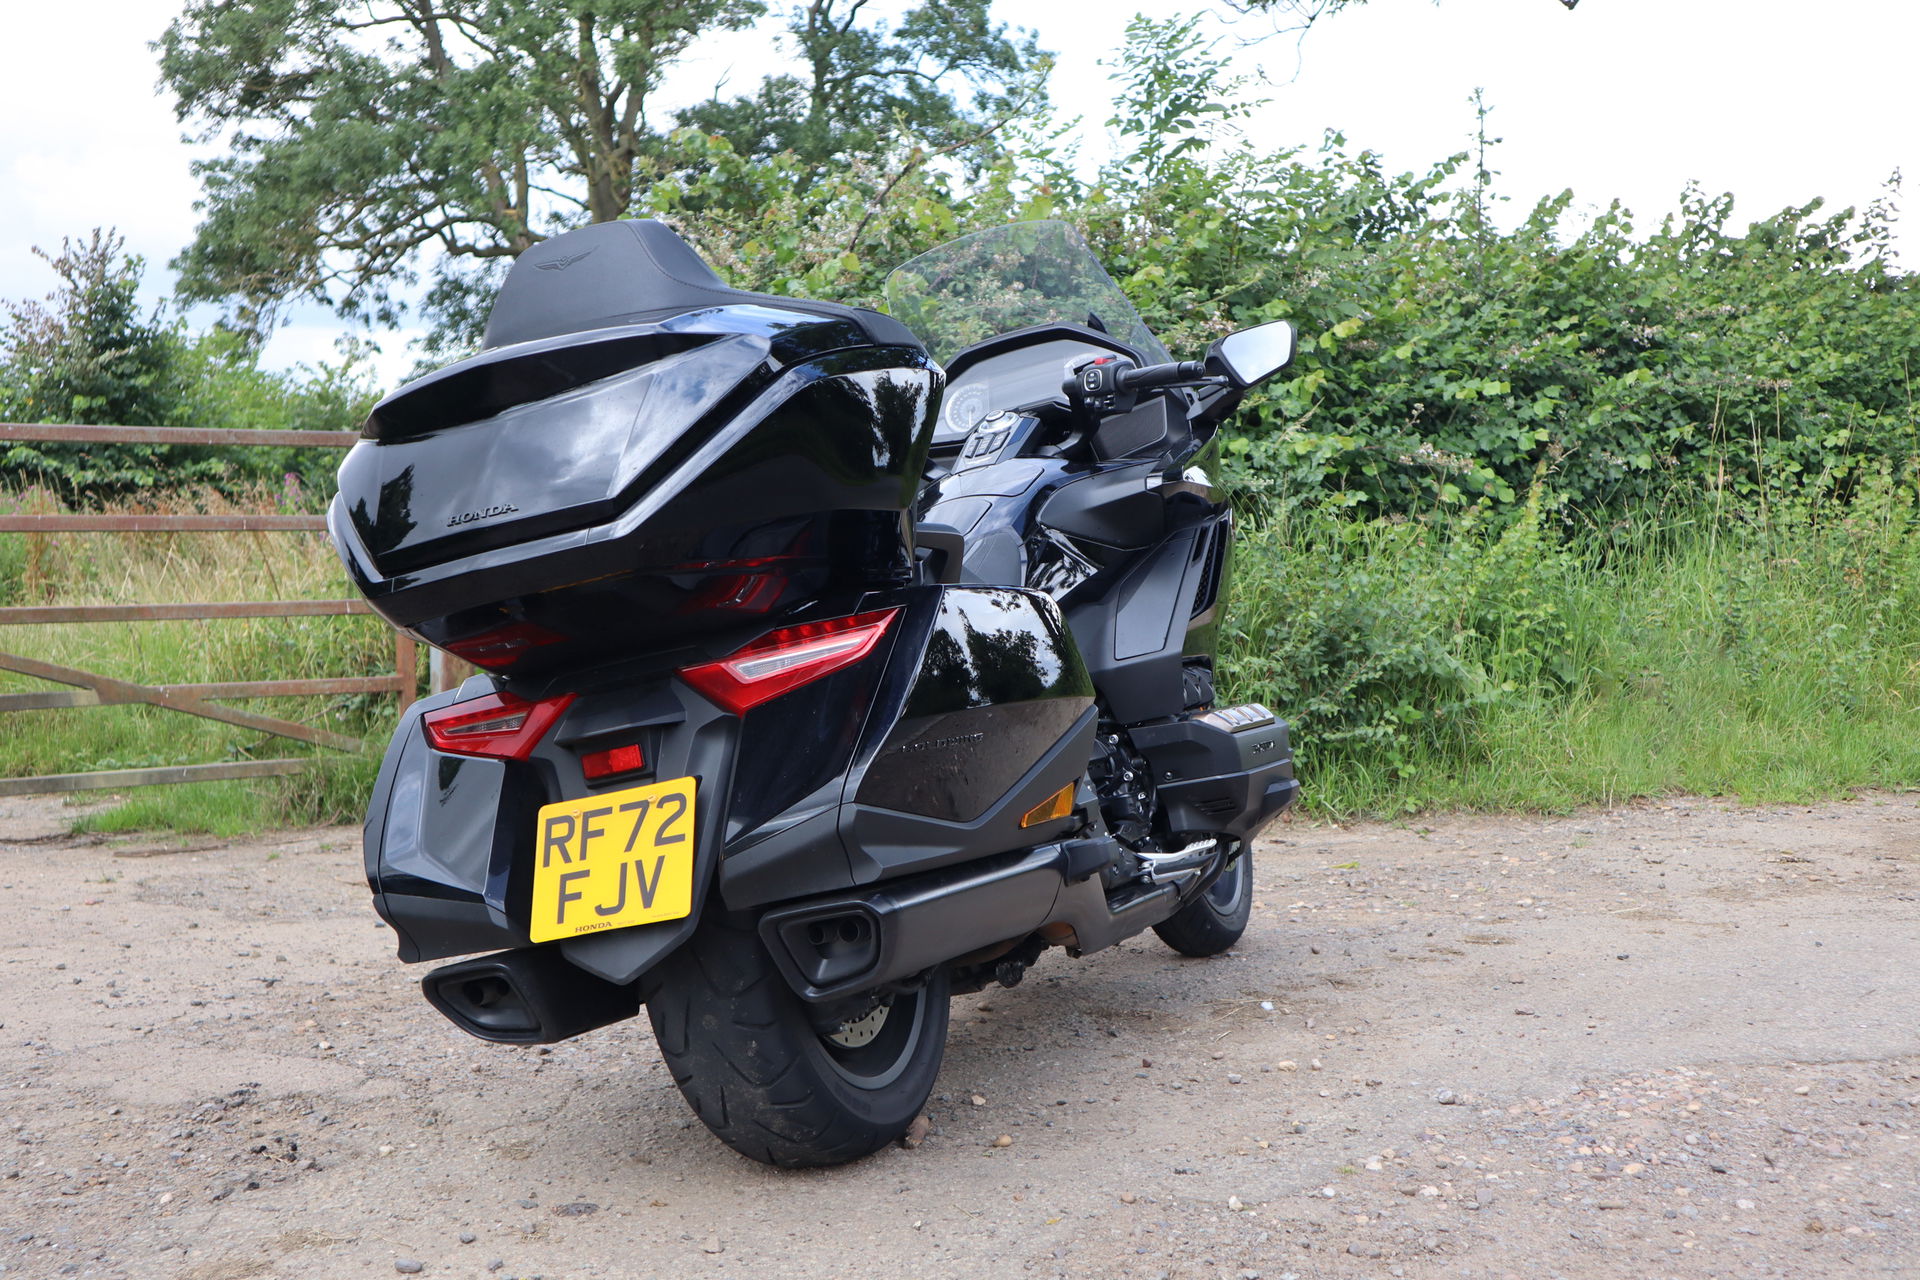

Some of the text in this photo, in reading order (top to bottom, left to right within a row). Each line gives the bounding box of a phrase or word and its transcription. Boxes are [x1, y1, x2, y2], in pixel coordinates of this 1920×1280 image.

[447, 503, 519, 527] HONDA
[543, 792, 687, 868] RF72
[556, 855, 666, 924] FJV
[574, 920, 613, 933] HONDA
